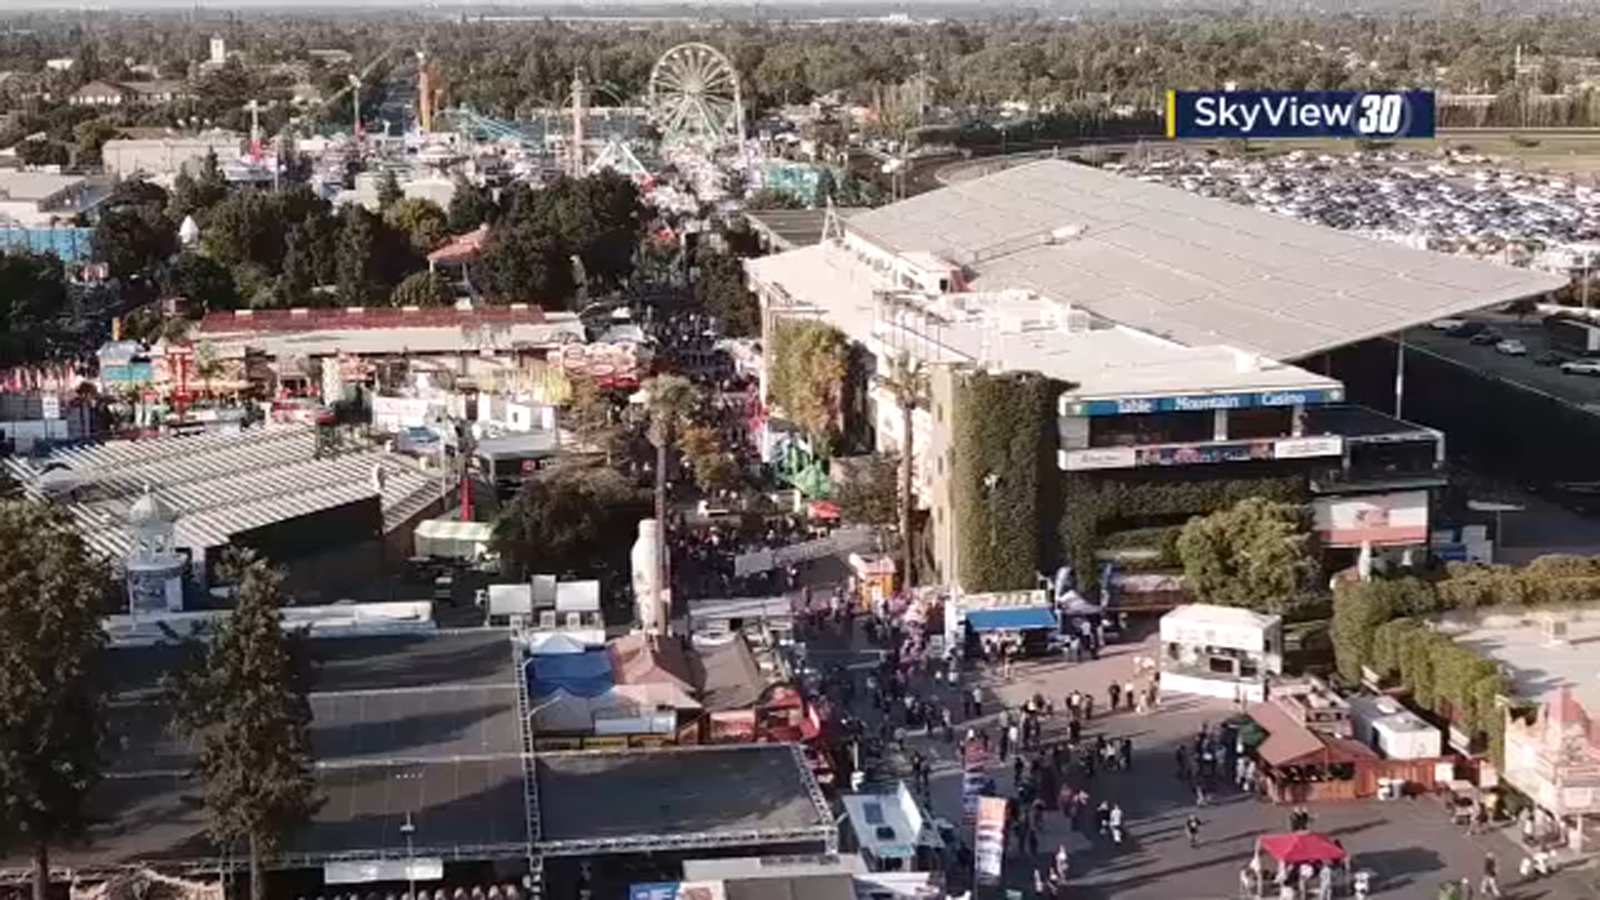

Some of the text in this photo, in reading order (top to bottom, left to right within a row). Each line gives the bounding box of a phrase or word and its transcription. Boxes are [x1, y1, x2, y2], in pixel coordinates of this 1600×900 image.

[1117, 391, 1306, 412] Table Mountain Casino
